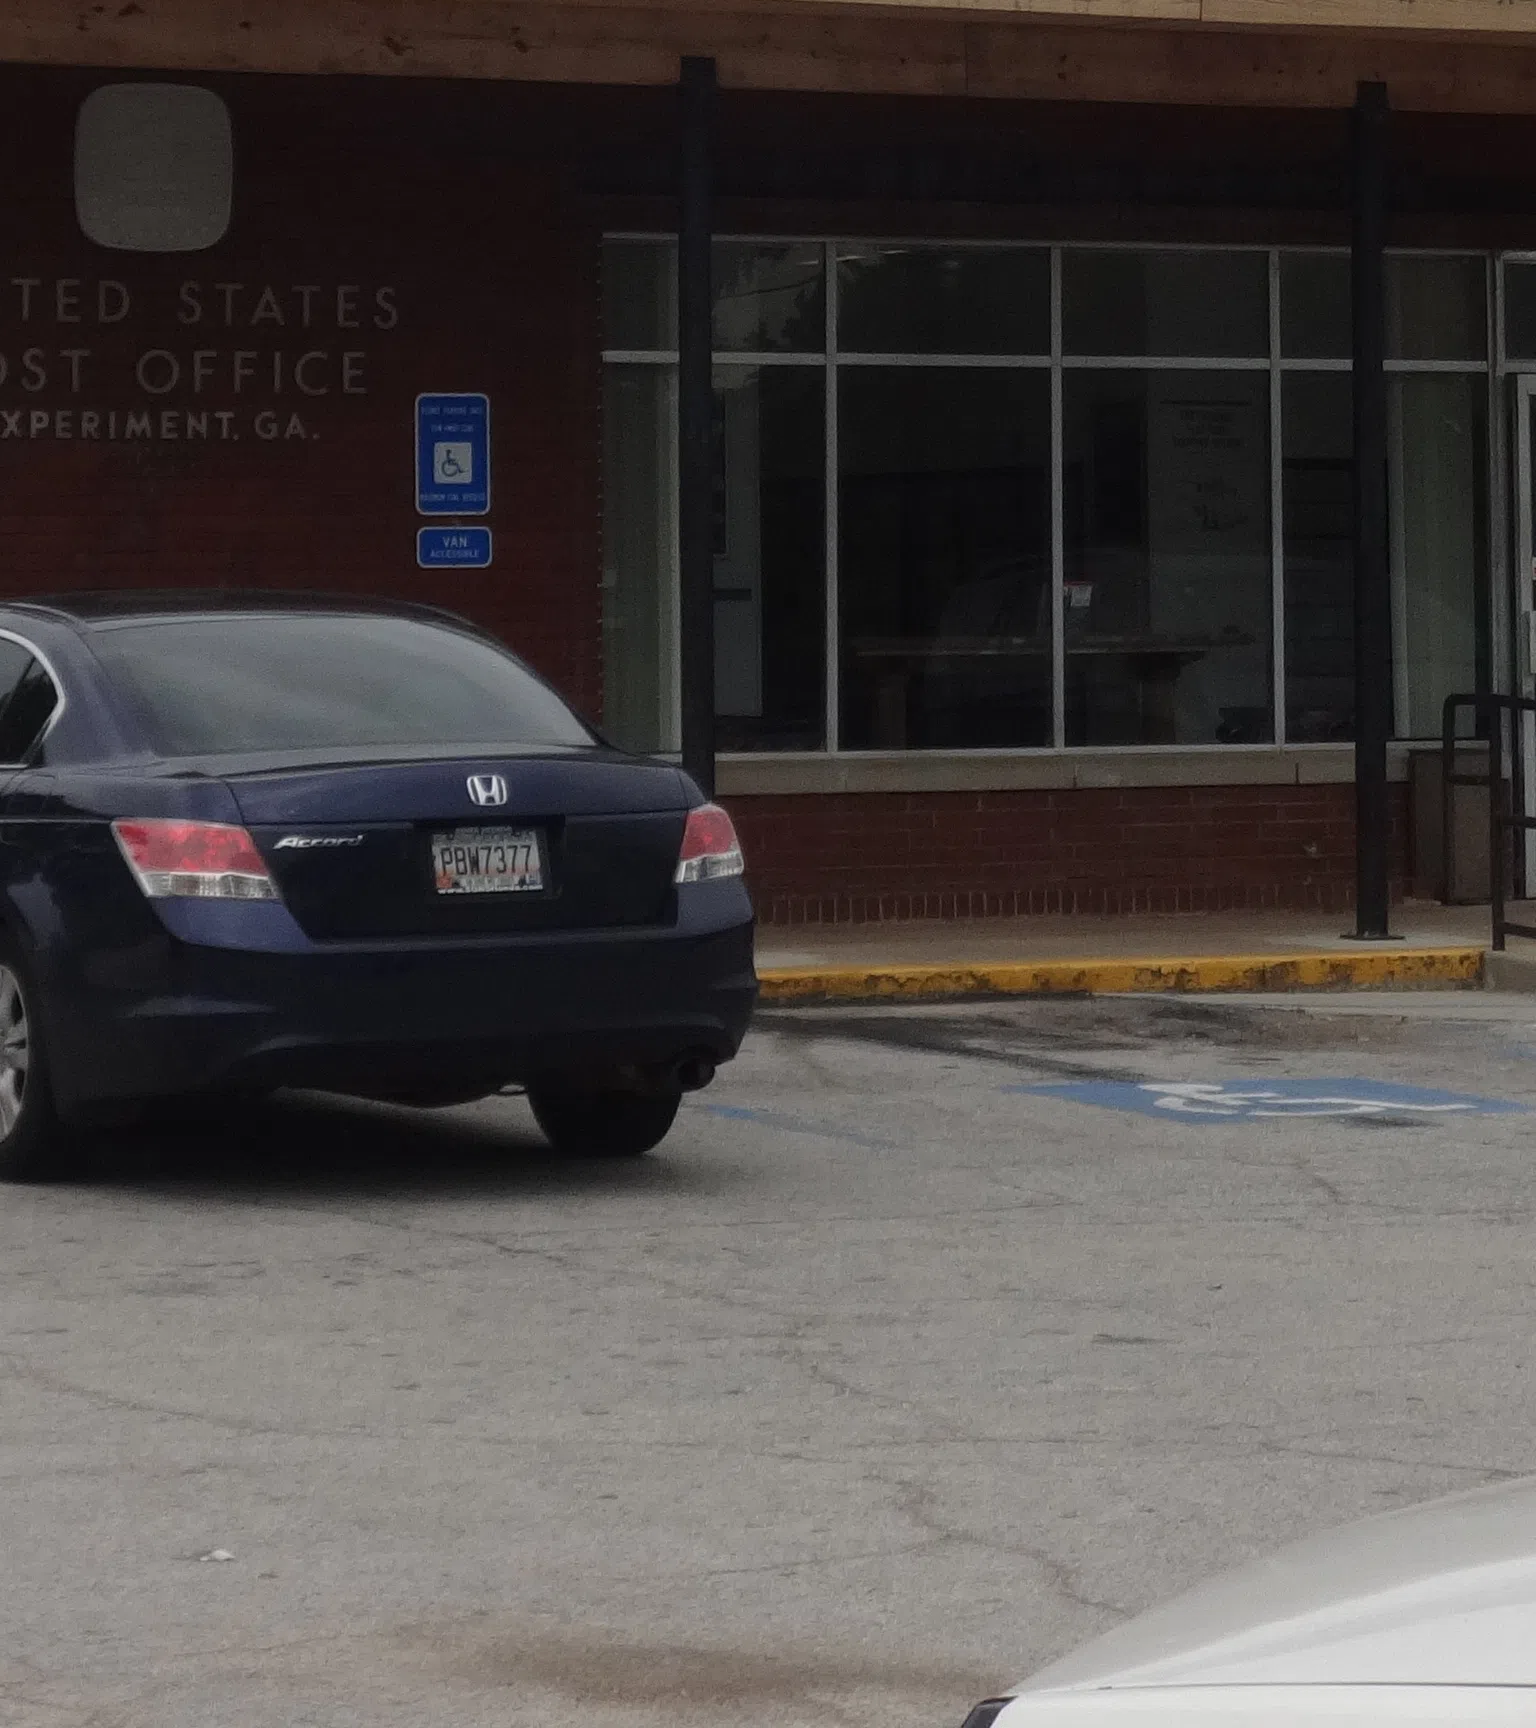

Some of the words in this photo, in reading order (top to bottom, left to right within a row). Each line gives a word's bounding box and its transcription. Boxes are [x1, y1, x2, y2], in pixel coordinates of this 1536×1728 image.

[177, 279, 400, 331] STATES
[136, 348, 368, 396] OFFICE
[253, 410, 321, 441] GA.
[442, 535, 468, 548] VAN
[272, 835, 363, 850] Accord
[440, 844, 532, 877] PBW7377
